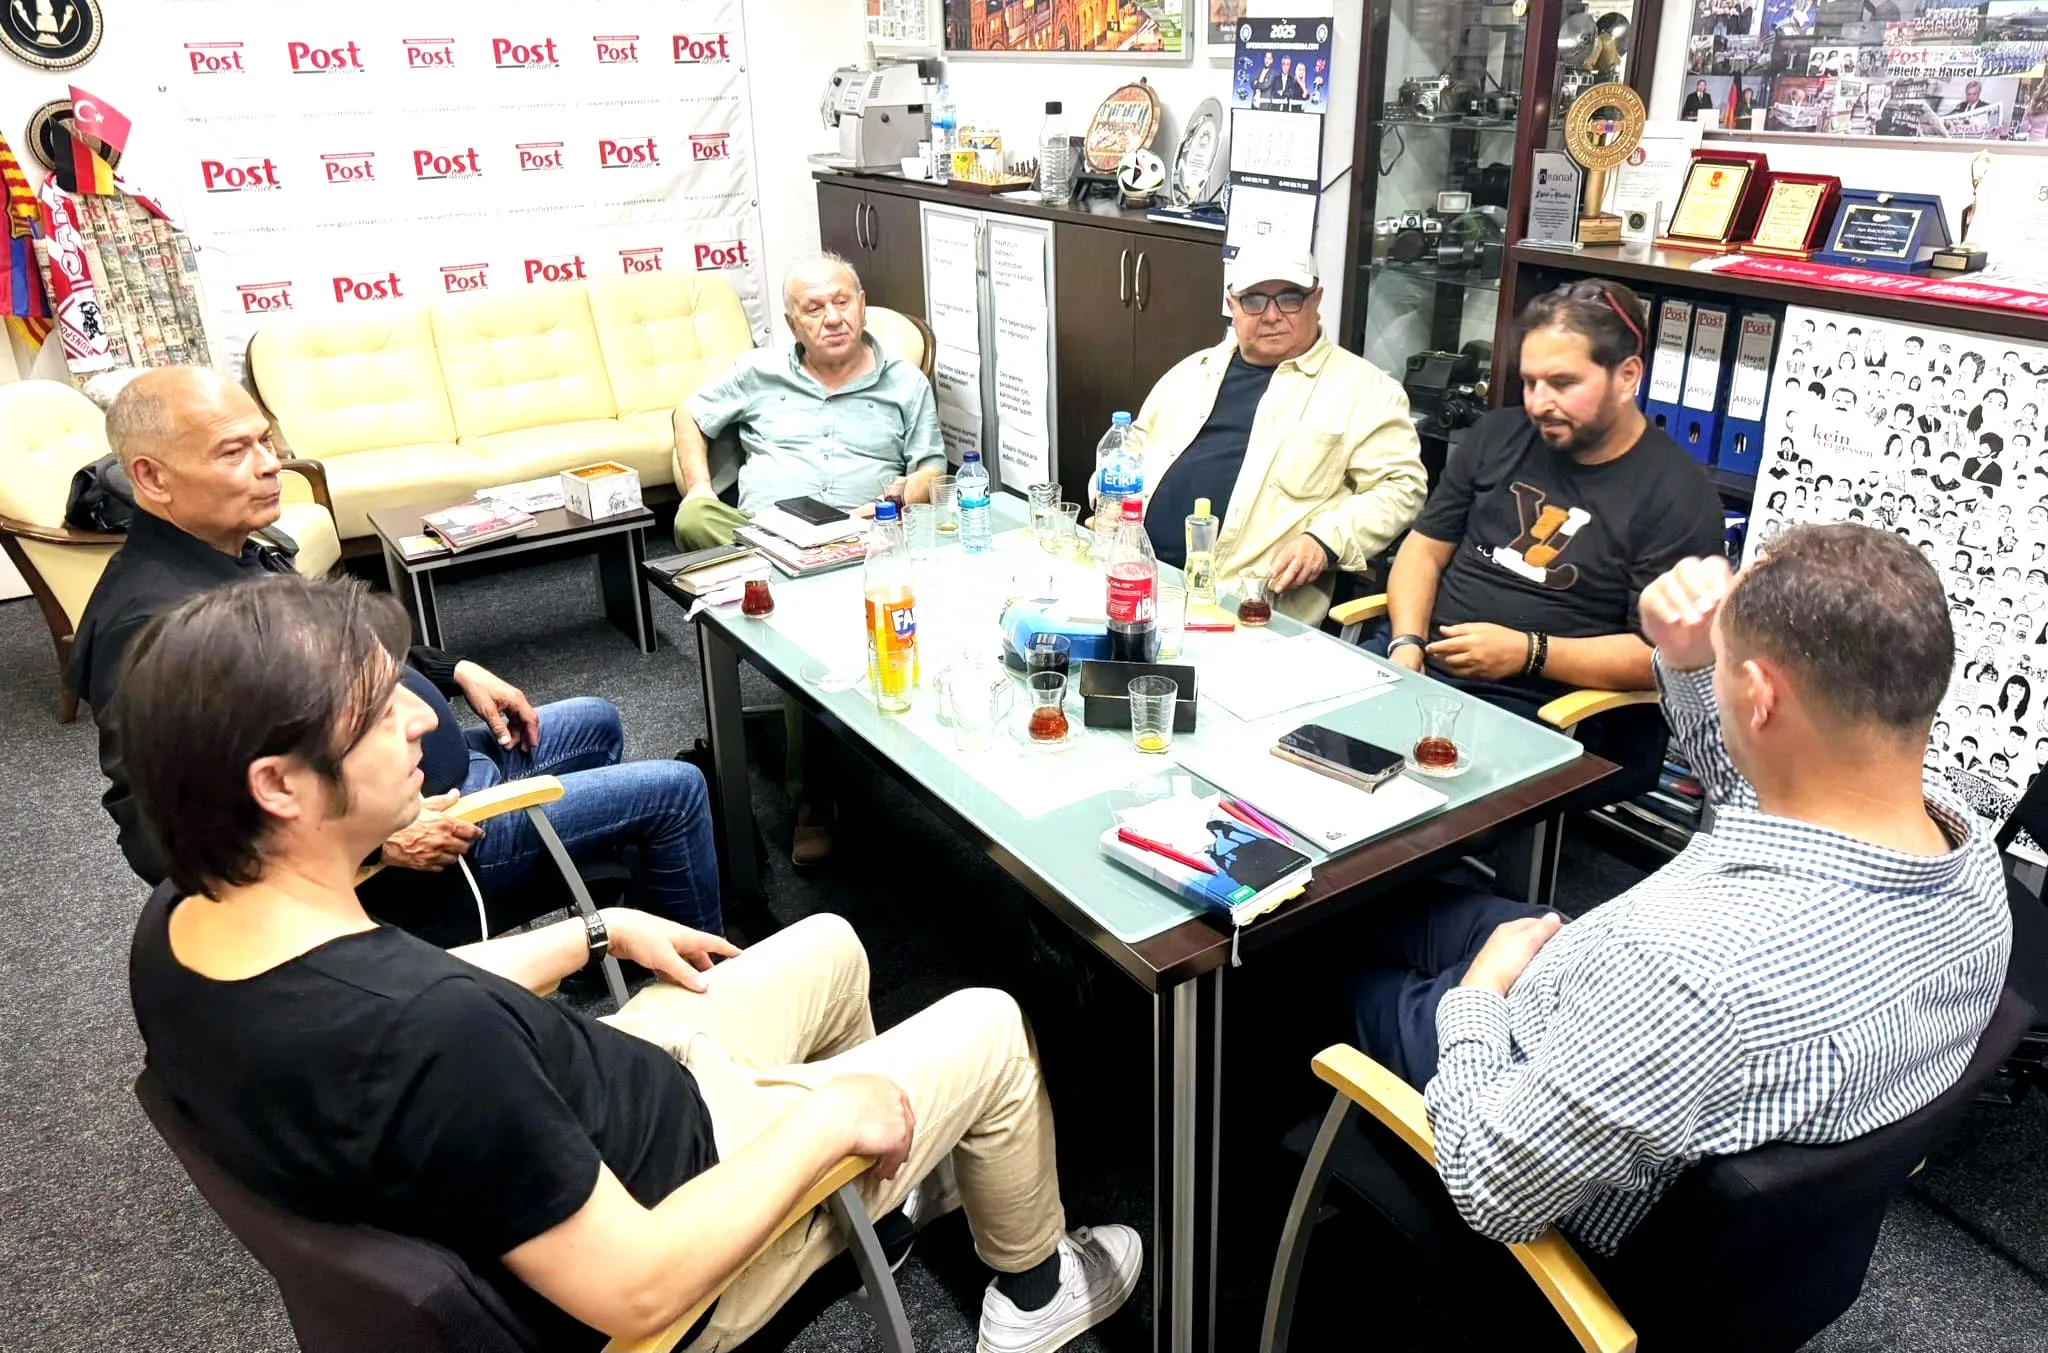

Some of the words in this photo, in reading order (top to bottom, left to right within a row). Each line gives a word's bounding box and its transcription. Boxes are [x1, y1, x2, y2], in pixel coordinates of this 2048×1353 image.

[1270, 24, 1297, 39] 2025
[288, 41, 362, 71] Post
[408, 46, 454, 66] Post
[492, 38, 559, 65] Post
[597, 42, 638, 62] Post
[673, 34, 727, 61] Post
[1889, 47, 1928, 64] Post
[190, 51, 244, 73] Post
[520, 151, 563, 169] Post
[599, 138, 658, 167] Post
[692, 142, 727, 158] Post
[325, 160, 374, 181] Post
[414, 148, 479, 176] Post
[201, 159, 279, 189] Post
[2037, 185, 2048, 203] 5
[621, 254, 660, 274] Post
[694, 242, 747, 269] Post
[524, 256, 586, 284] Post
[333, 273, 401, 303] Post
[444, 271, 488, 291] Post
[242, 291, 289, 312] Post
[1665, 307, 1688, 322] Post
[1699, 313, 1723, 328] Post
[1746, 320, 1771, 335] Post
[1699, 346, 1716, 355] Ayna
[1744, 353, 1765, 363] Hayat
[1813, 423, 1850, 446] kein
[1816, 440, 1873, 459] vergessen
